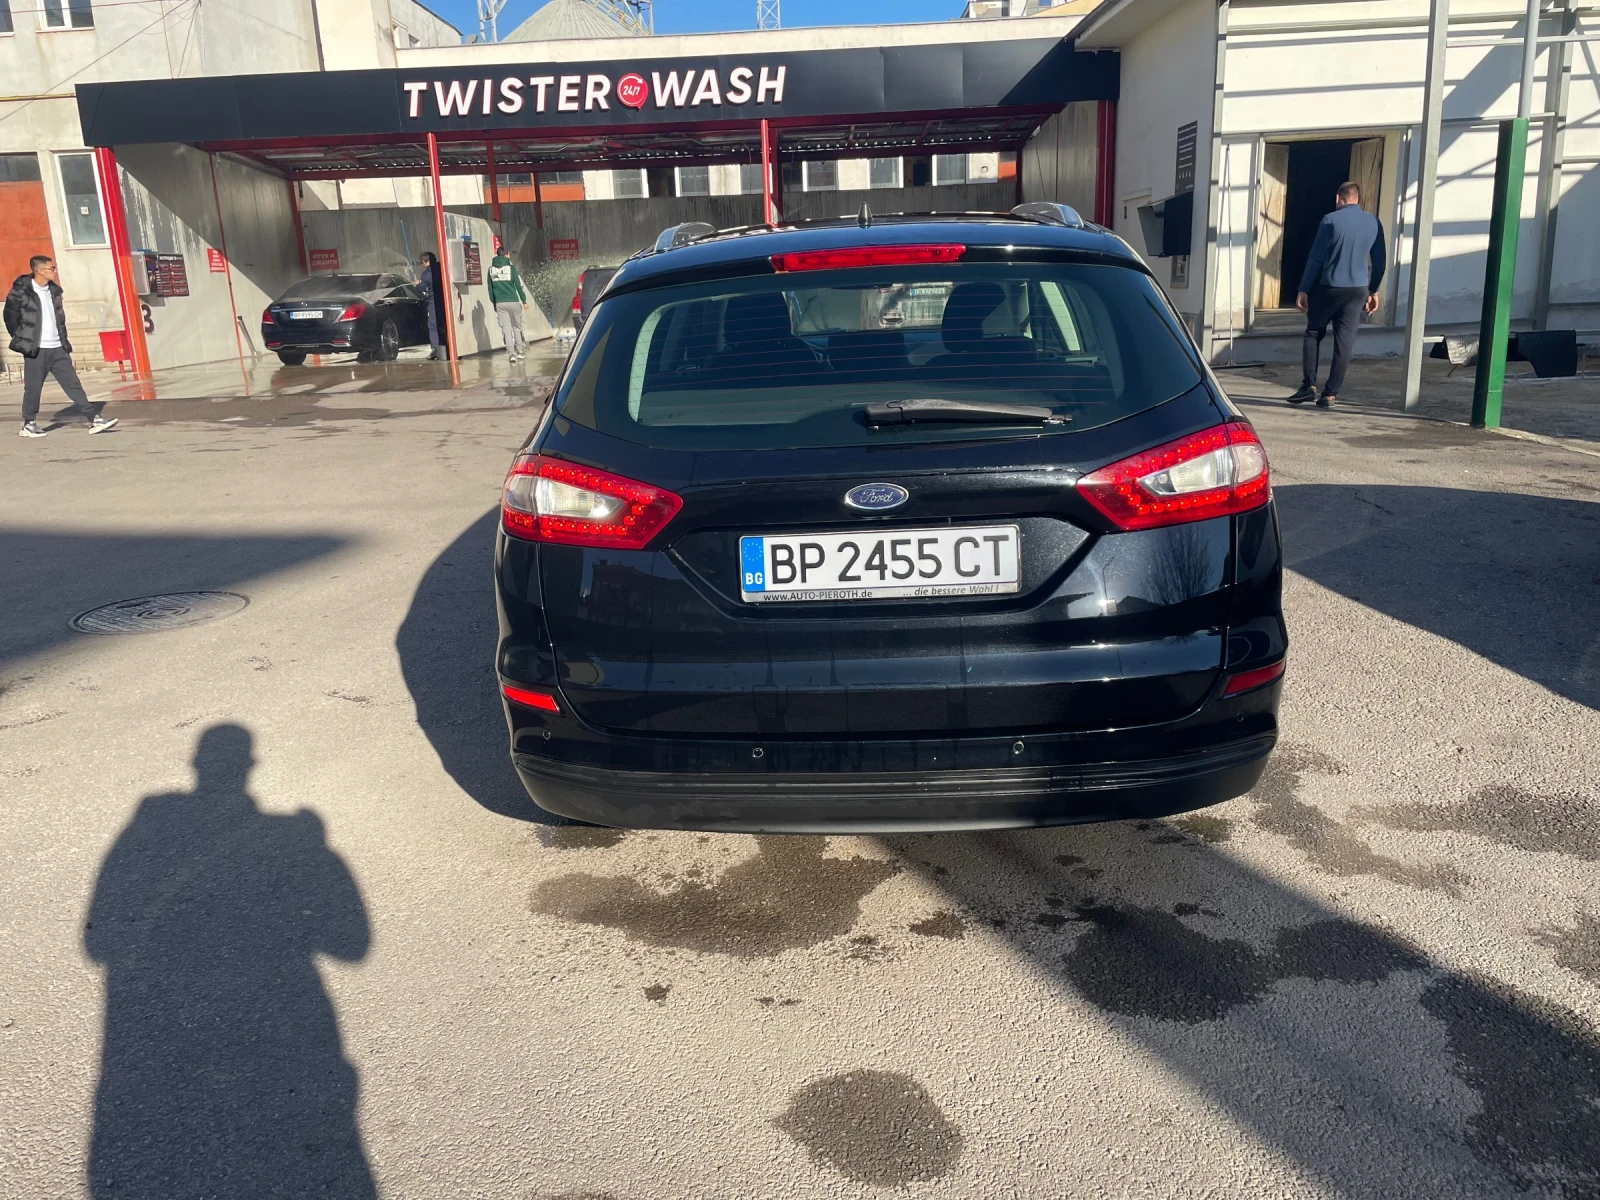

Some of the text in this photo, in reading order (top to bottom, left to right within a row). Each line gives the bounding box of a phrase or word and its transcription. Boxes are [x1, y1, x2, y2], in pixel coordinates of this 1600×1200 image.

[403, 66, 787, 117] TWISTER 24/7 WASH
[860, 488, 894, 503] Ford
[770, 534, 1009, 585] BP 2455 CT
[745, 572, 763, 585] BG
[763, 589, 873, 602] www.AUTO-PIEROTH.de
[914, 586, 929, 596] die
[931, 586, 967, 596] bessere
[969, 584, 994, 594] Wahl
